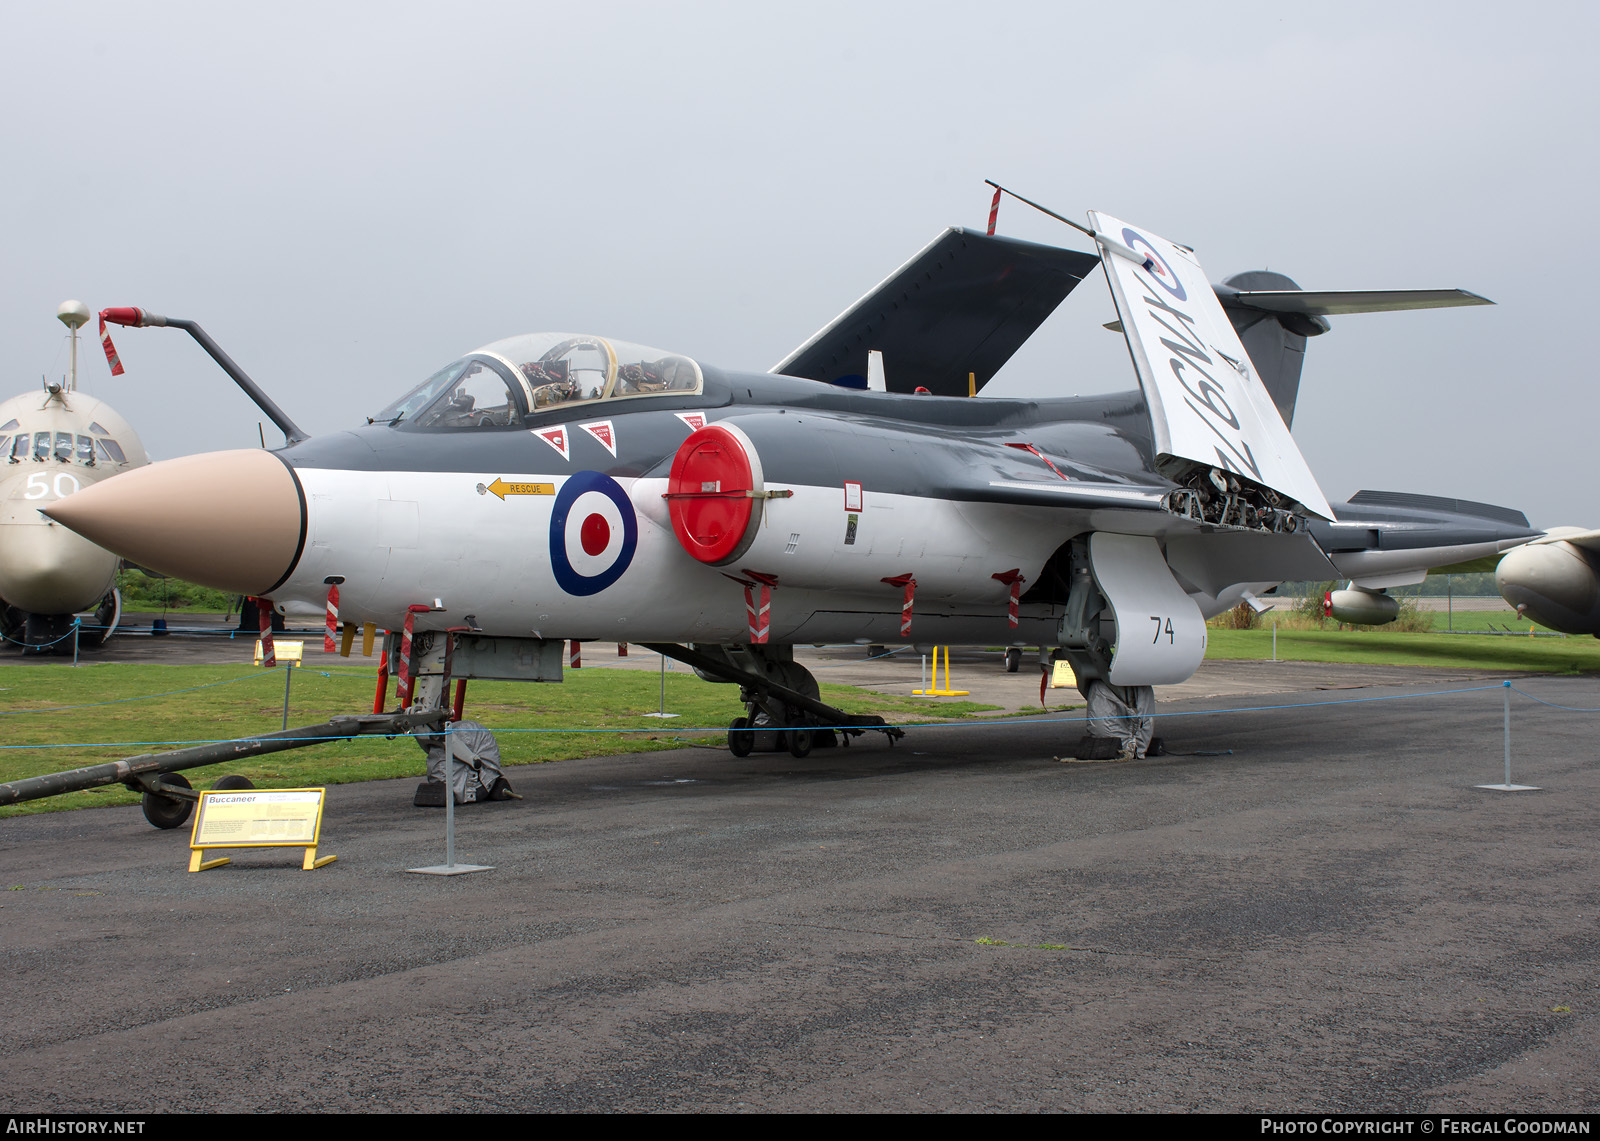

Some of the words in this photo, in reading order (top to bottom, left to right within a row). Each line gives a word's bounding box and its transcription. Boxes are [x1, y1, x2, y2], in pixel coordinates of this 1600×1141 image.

[24, 472, 79, 499] 50
[510, 484, 541, 493] RESCUE
[1150, 616, 1174, 645] 74
[209, 796, 256, 804] Buccaneer
